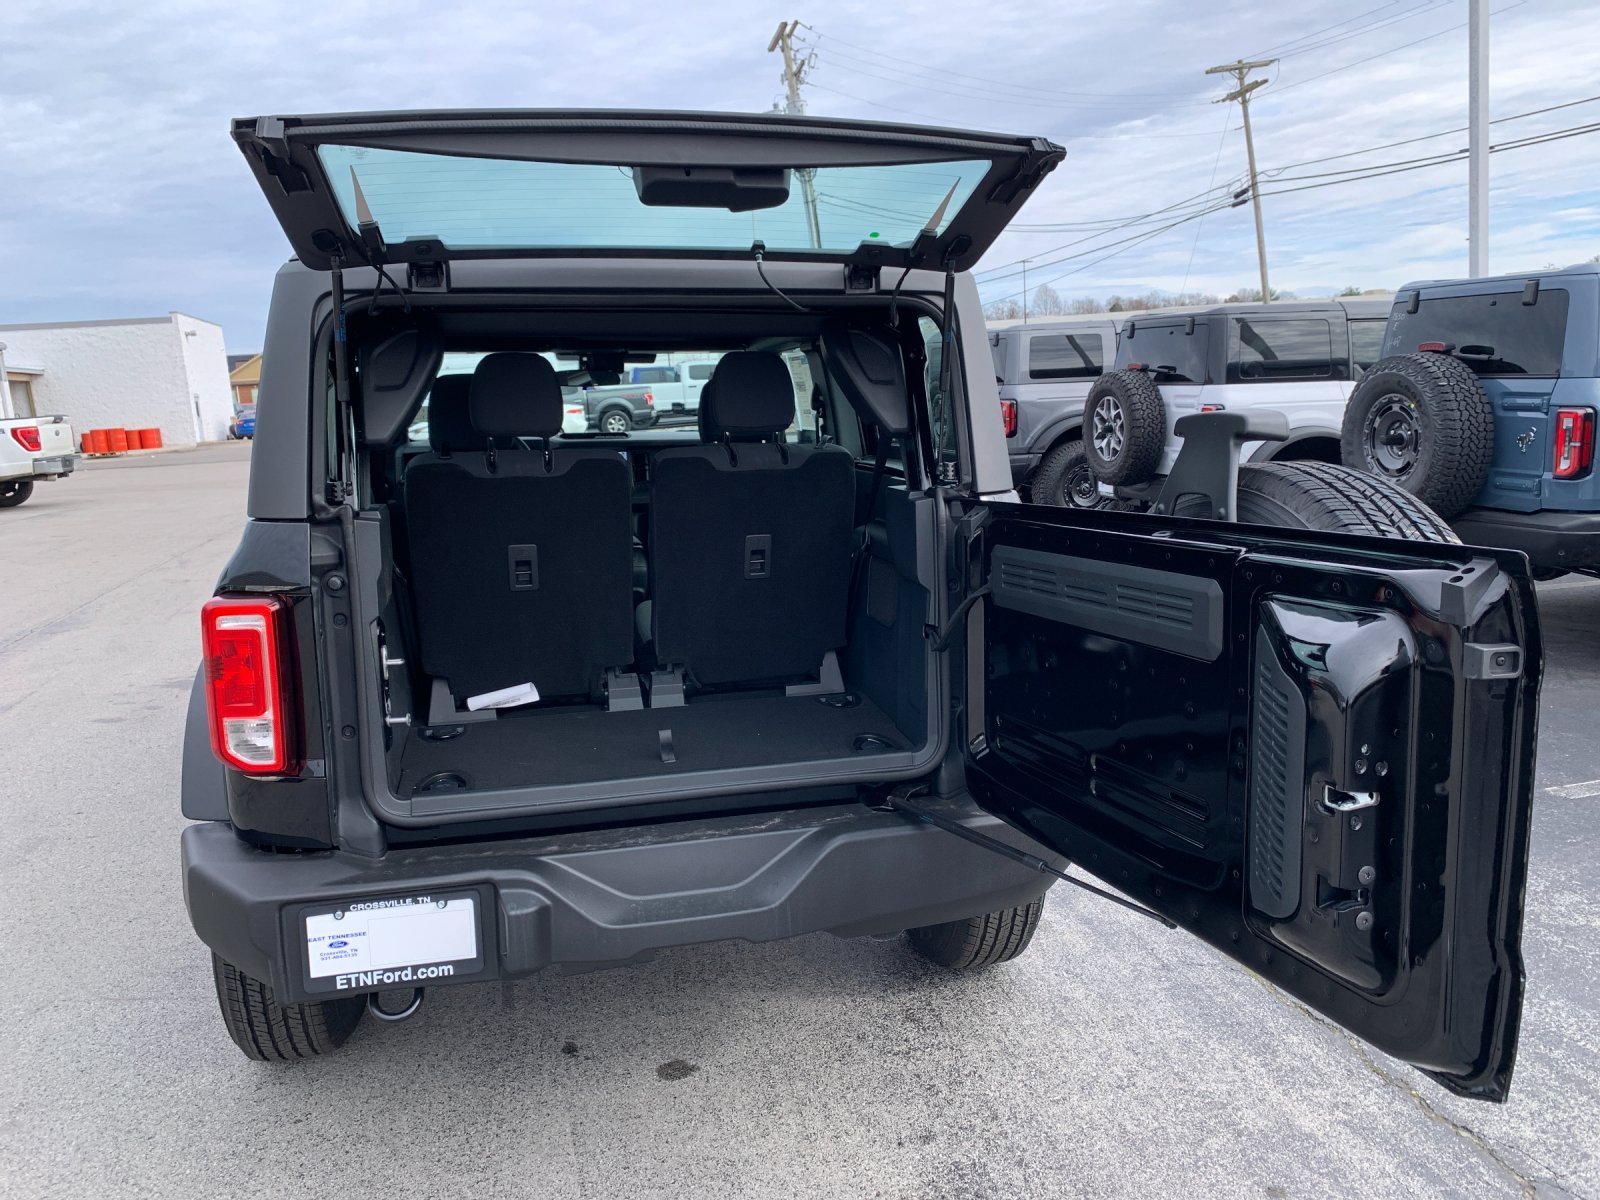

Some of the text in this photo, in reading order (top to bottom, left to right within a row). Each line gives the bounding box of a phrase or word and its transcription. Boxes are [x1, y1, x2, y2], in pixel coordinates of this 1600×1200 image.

[350, 896, 431, 912] CROSSVILLE, TN
[308, 931, 367, 943] EAST TENNESSEE
[336, 964, 454, 990] ETNFord.com
